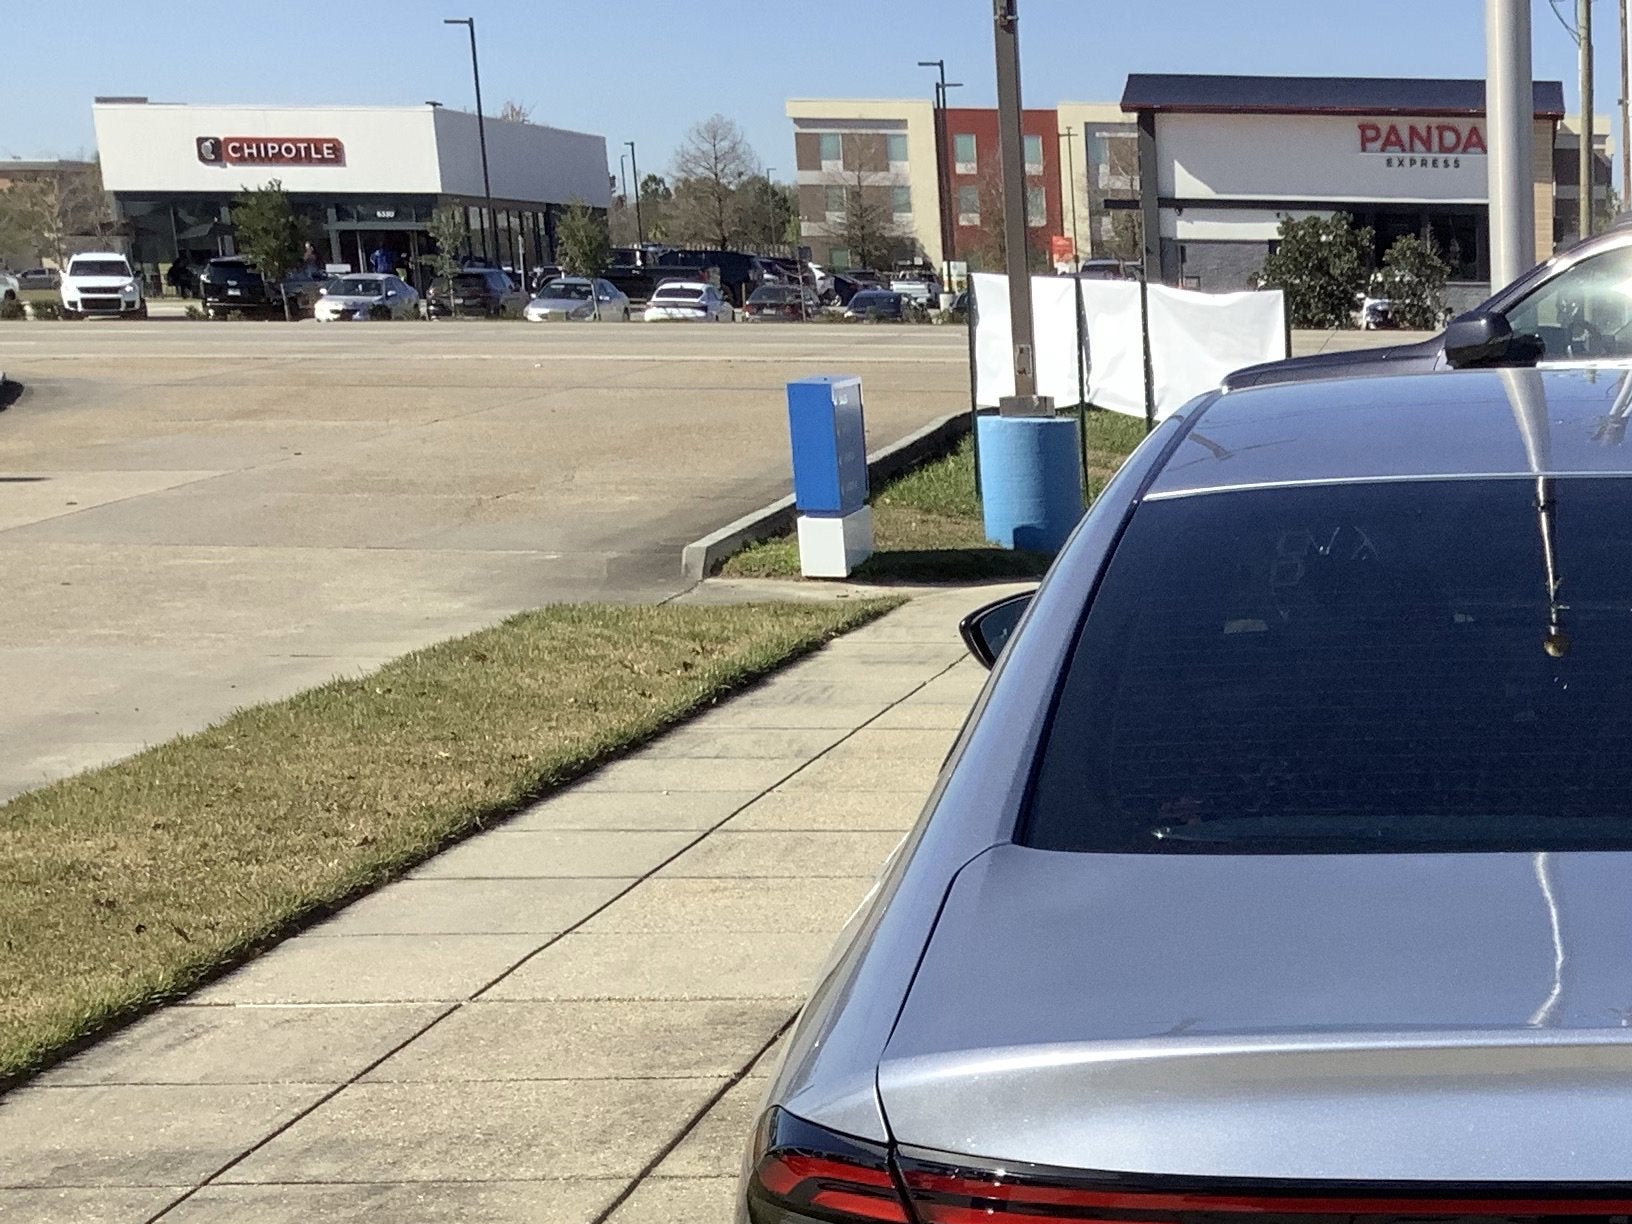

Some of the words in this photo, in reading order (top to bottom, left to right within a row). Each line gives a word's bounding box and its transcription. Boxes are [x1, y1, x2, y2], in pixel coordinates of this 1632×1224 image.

[1358, 124, 1487, 154] PANDA
[228, 142, 336, 159] CHIPOTLE
[1386, 157, 1460, 169] EXPRESS
